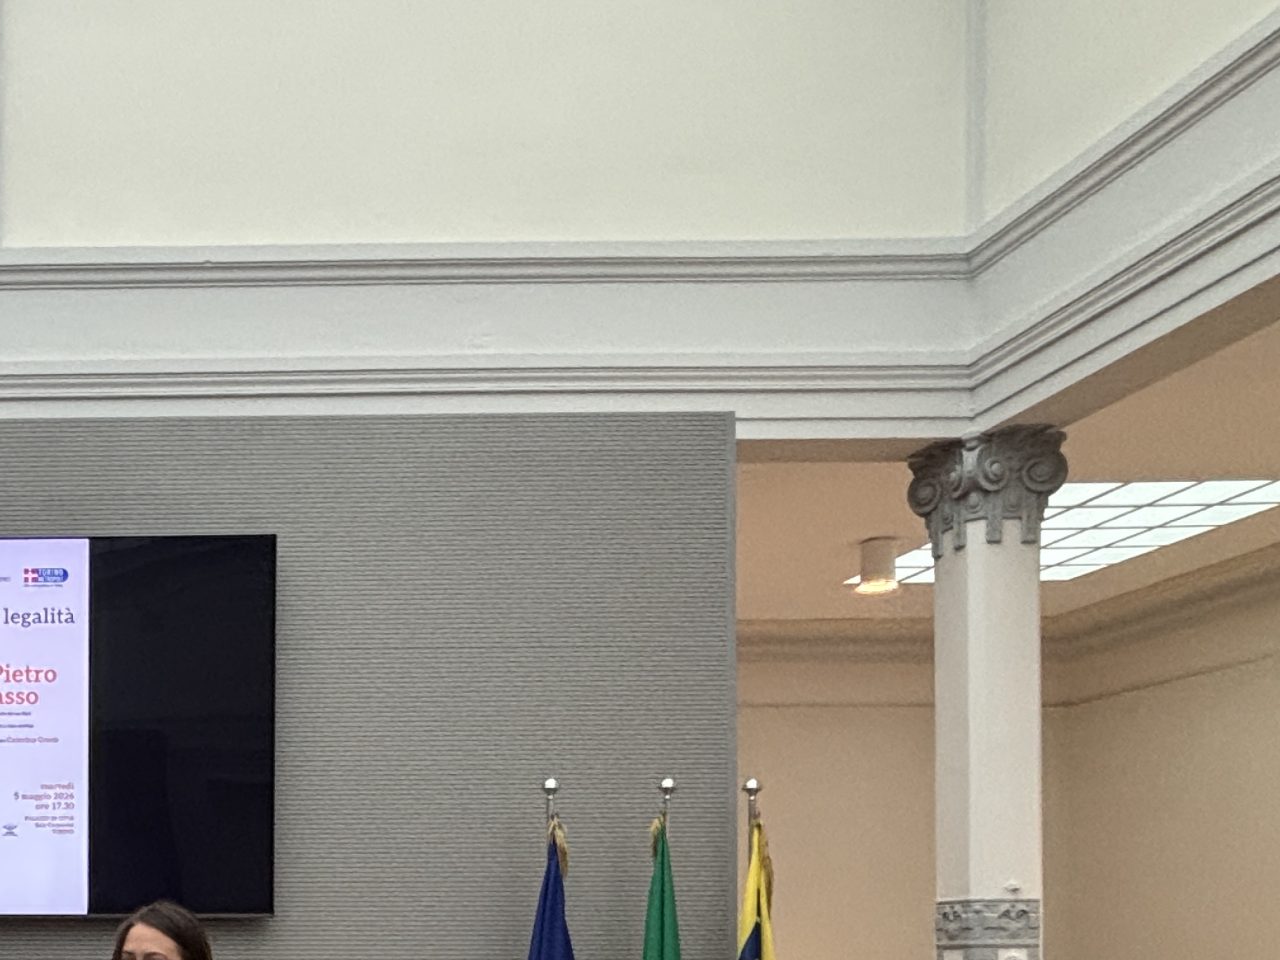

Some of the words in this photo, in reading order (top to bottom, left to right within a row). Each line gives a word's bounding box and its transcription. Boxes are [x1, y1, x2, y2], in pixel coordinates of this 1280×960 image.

[3, 607, 75, 628] legalità
[53, 792, 75, 800] 2026
[52, 802, 75, 810] 17.30
